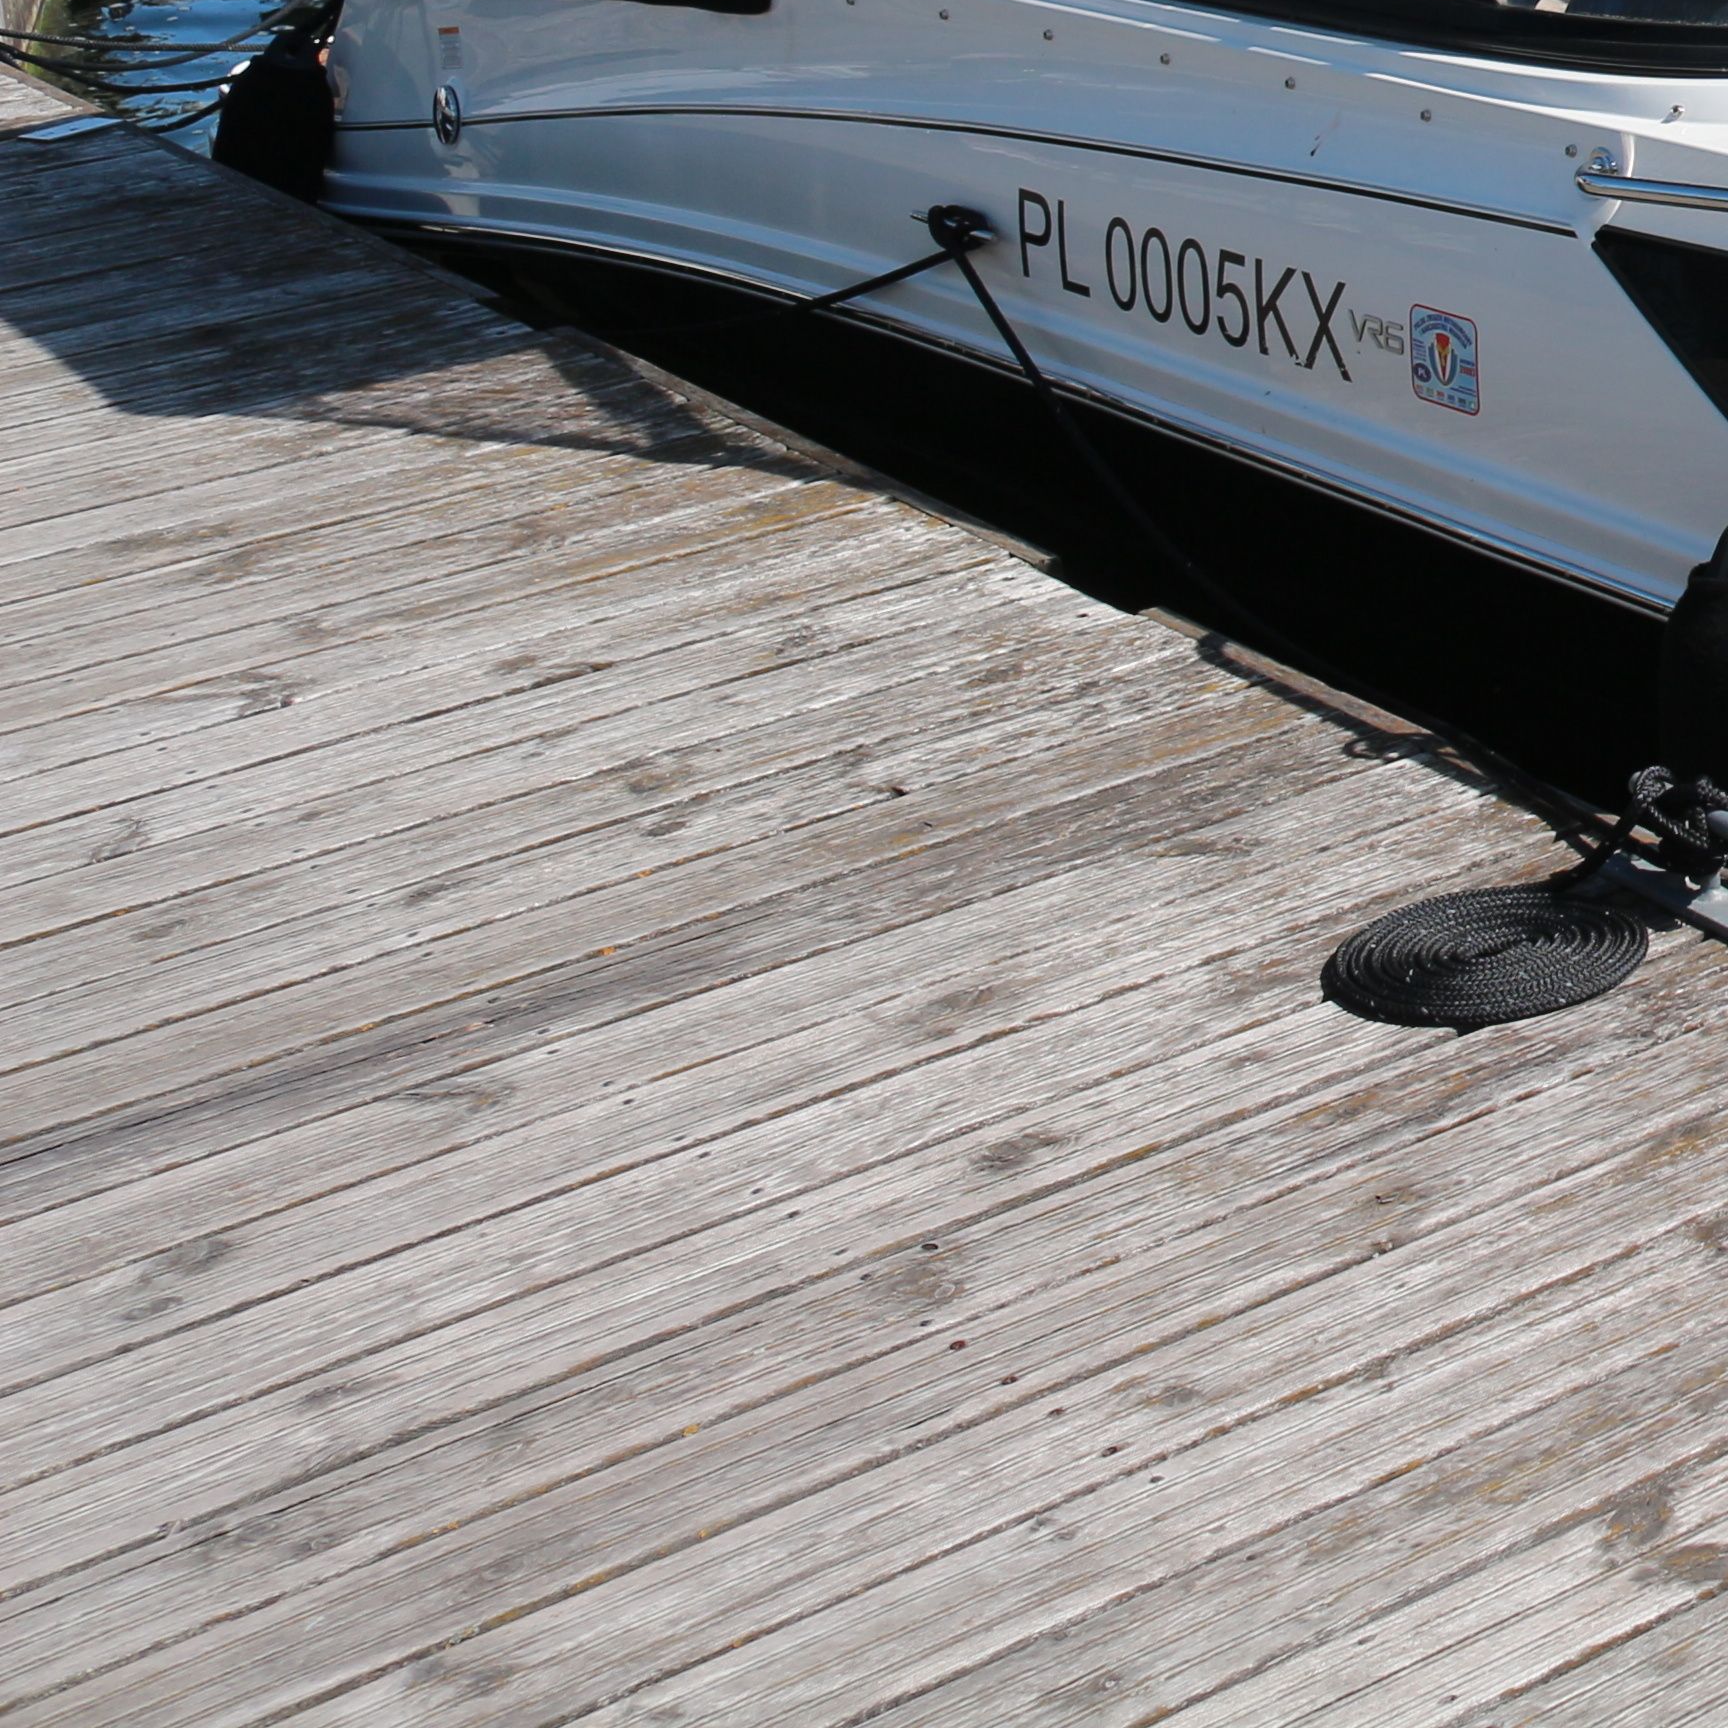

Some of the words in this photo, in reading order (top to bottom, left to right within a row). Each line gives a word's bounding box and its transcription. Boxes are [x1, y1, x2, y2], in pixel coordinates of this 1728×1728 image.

[1018, 187, 1092, 298] PL
[1104, 216, 1353, 383] 0005KX
[1348, 308, 1405, 356] VR6
